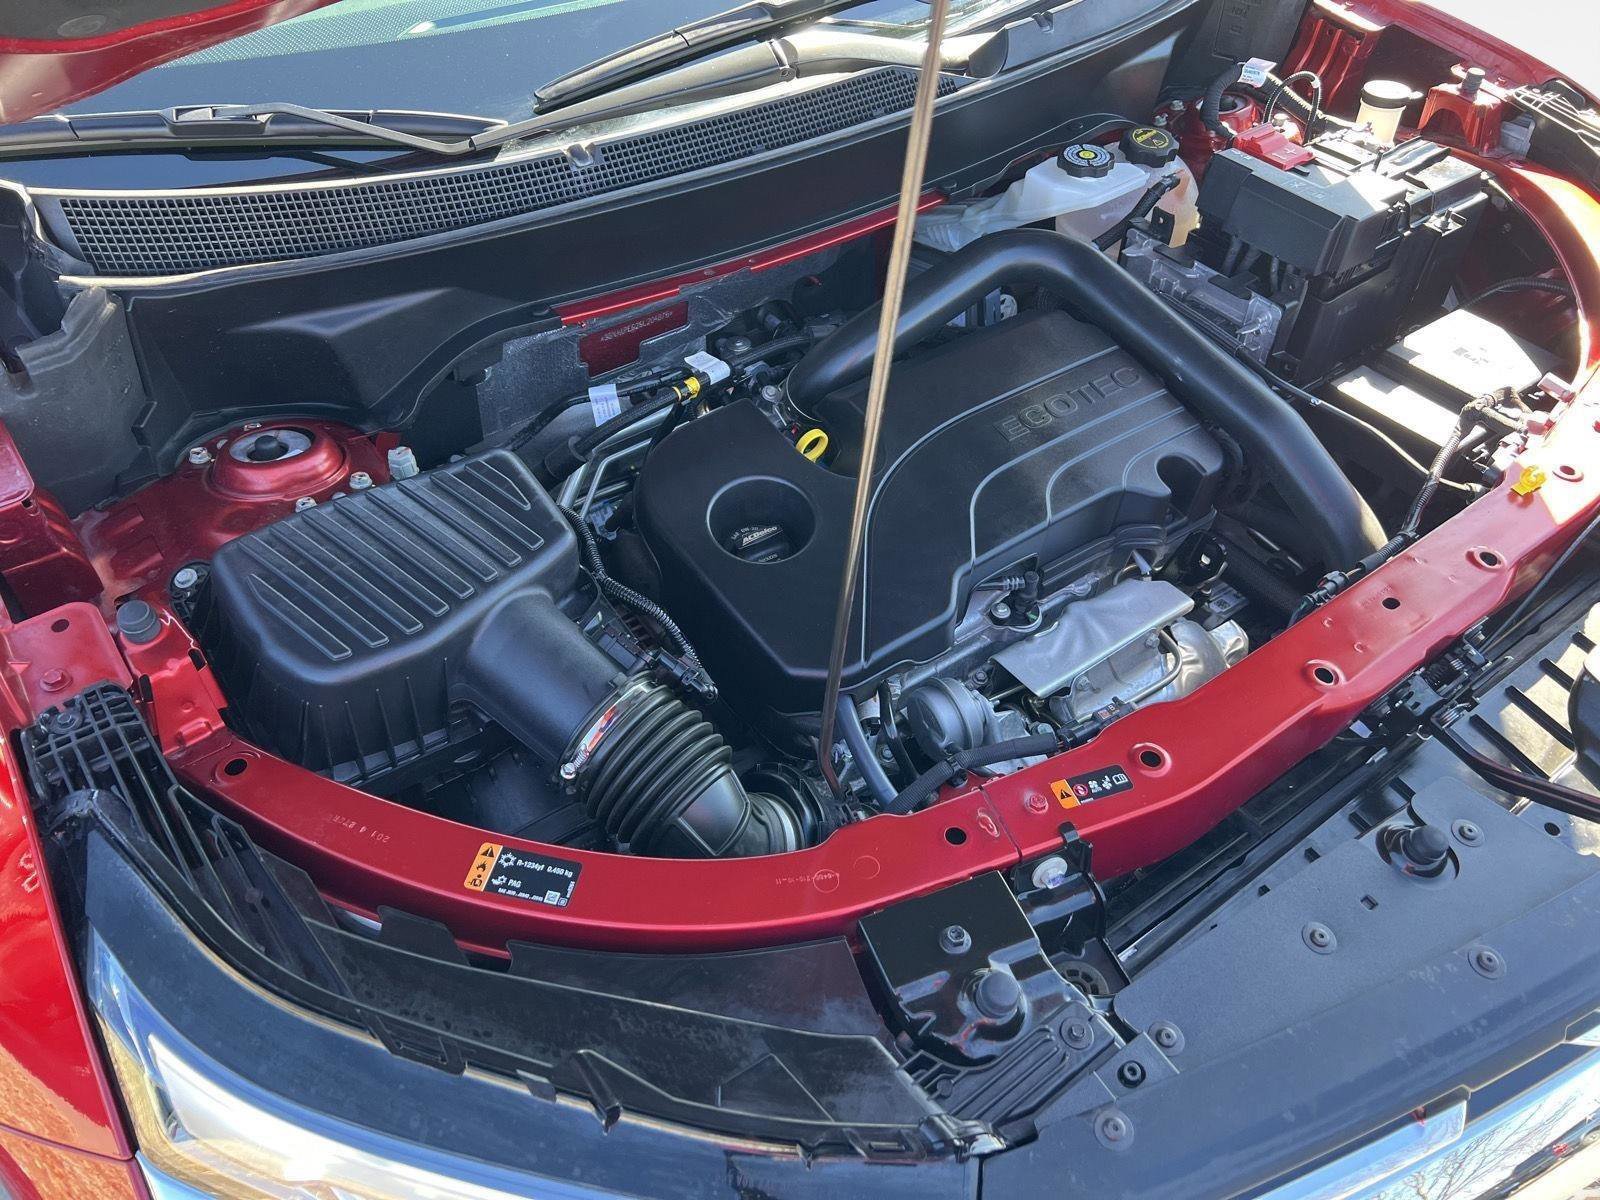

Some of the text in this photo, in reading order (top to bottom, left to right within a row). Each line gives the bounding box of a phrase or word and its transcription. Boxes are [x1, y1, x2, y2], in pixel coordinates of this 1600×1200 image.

[992, 366, 1142, 442] ECOTEC
[742, 526, 778, 545] ACDelco
[516, 859, 545, 872] R-1234yf
[564, 868, 574, 879] kg
[507, 879, 522, 888] PAG
